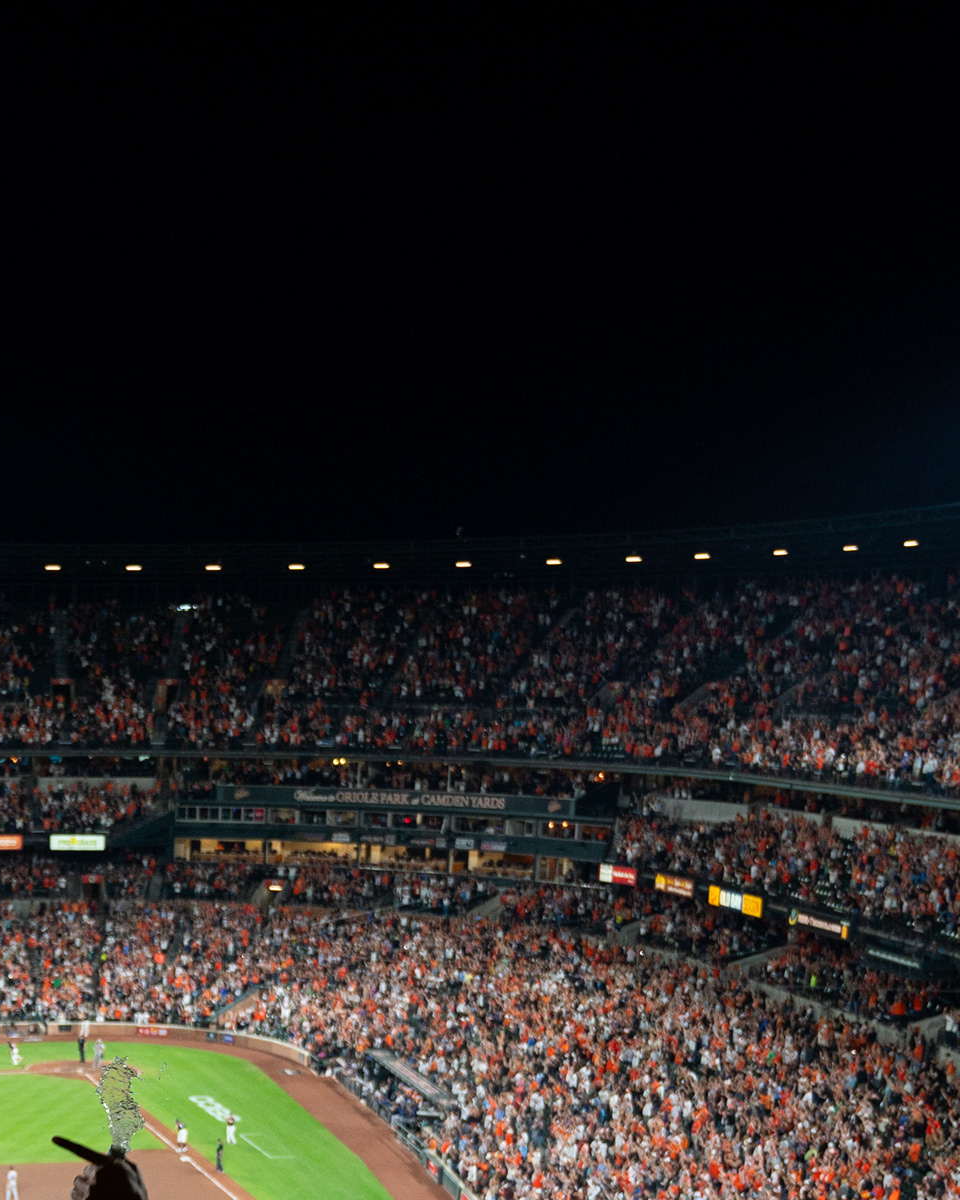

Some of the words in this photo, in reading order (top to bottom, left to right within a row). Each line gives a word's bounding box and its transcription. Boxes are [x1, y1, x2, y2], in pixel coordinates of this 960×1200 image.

[336, 792, 379, 804] ORIOLE
[380, 793, 410, 805] PARK
[421, 794, 471, 808] CAMDEN
[471, 796, 505, 810] YARDS
